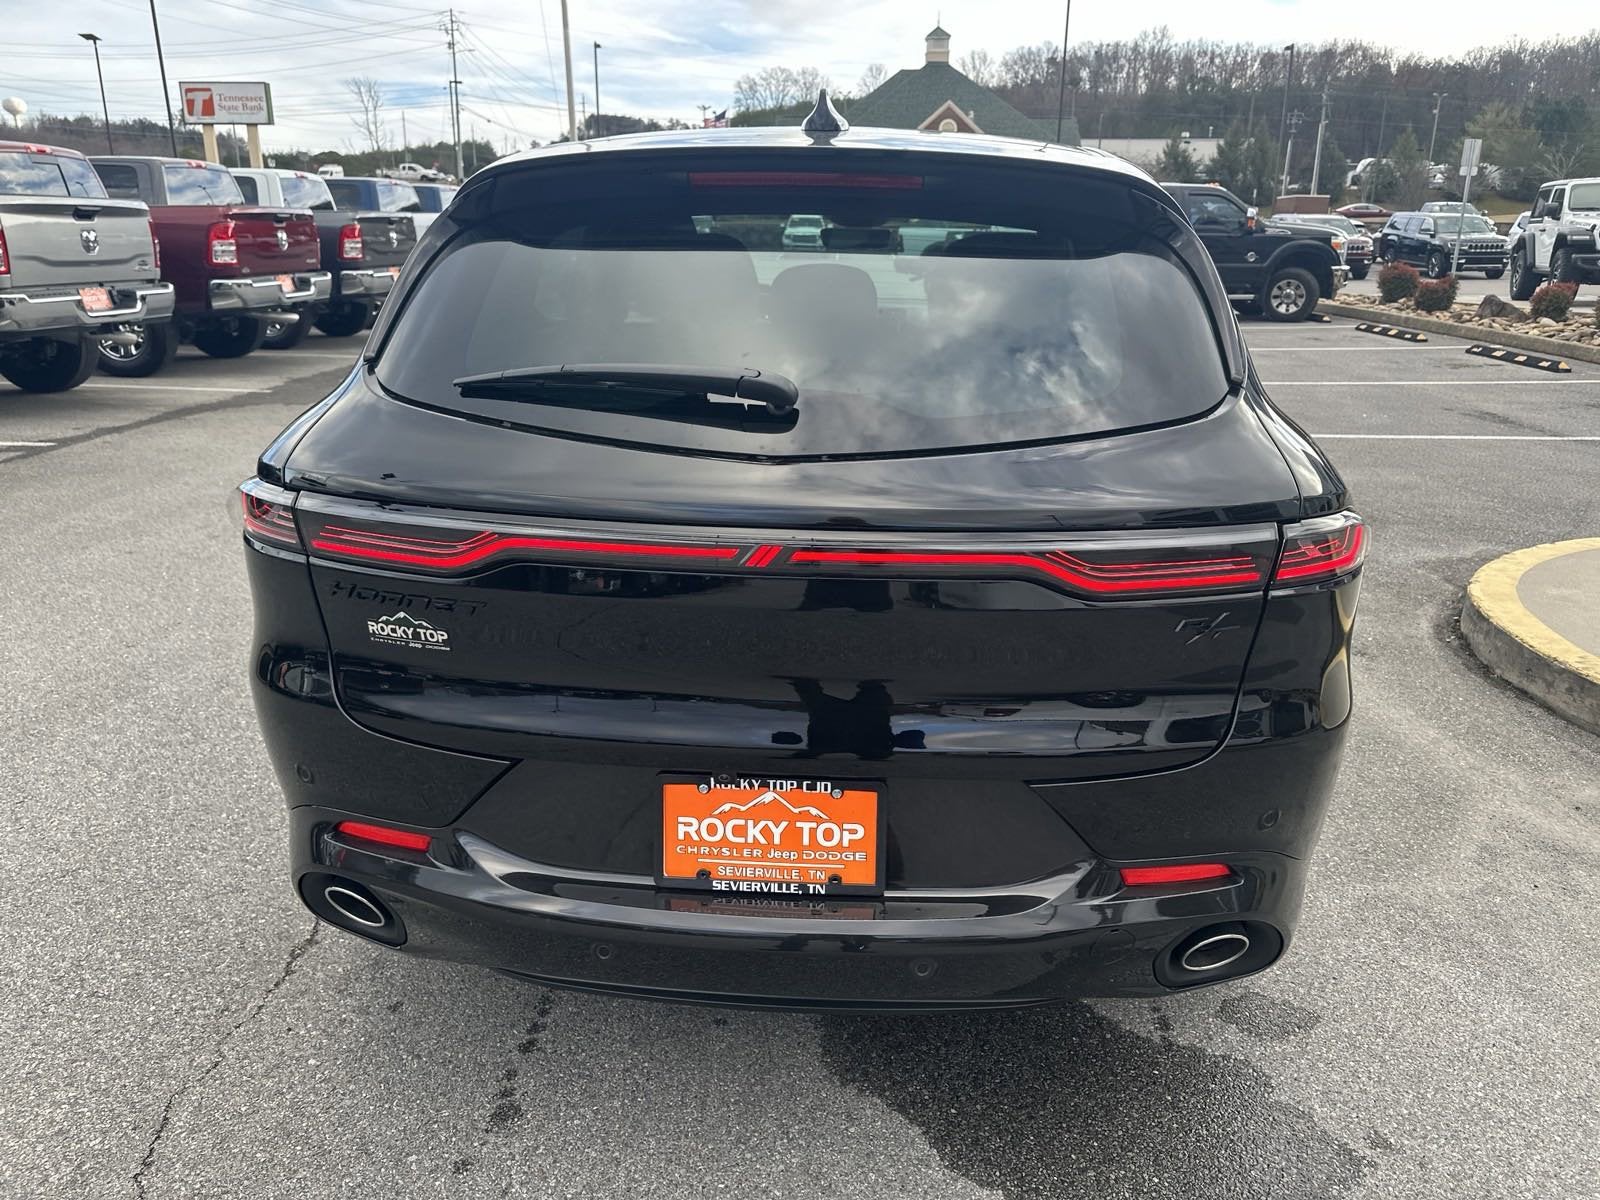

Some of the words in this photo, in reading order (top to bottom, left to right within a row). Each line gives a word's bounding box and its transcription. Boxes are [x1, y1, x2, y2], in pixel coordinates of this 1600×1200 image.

[216, 93, 264, 102] Tennessee
[217, 103, 240, 112] State
[241, 103, 264, 112] Bank
[330, 580, 488, 616] HORNET
[367, 621, 414, 639] ROCKY
[416, 628, 448, 642] TOP
[766, 779, 798, 793] TOP
[802, 781, 832, 794] CJD
[676, 816, 788, 846] ROCKY
[795, 821, 865, 848] TOP
[676, 845, 762, 858] CHRYSLER
[767, 849, 798, 861] Jeep
[802, 850, 867, 861] DODGE
[717, 866, 803, 881] SEVIERVILLE,
[808, 870, 826, 880] TN
[712, 880, 803, 895] SEVIERVILLE,
[807, 883, 826, 895] TN
